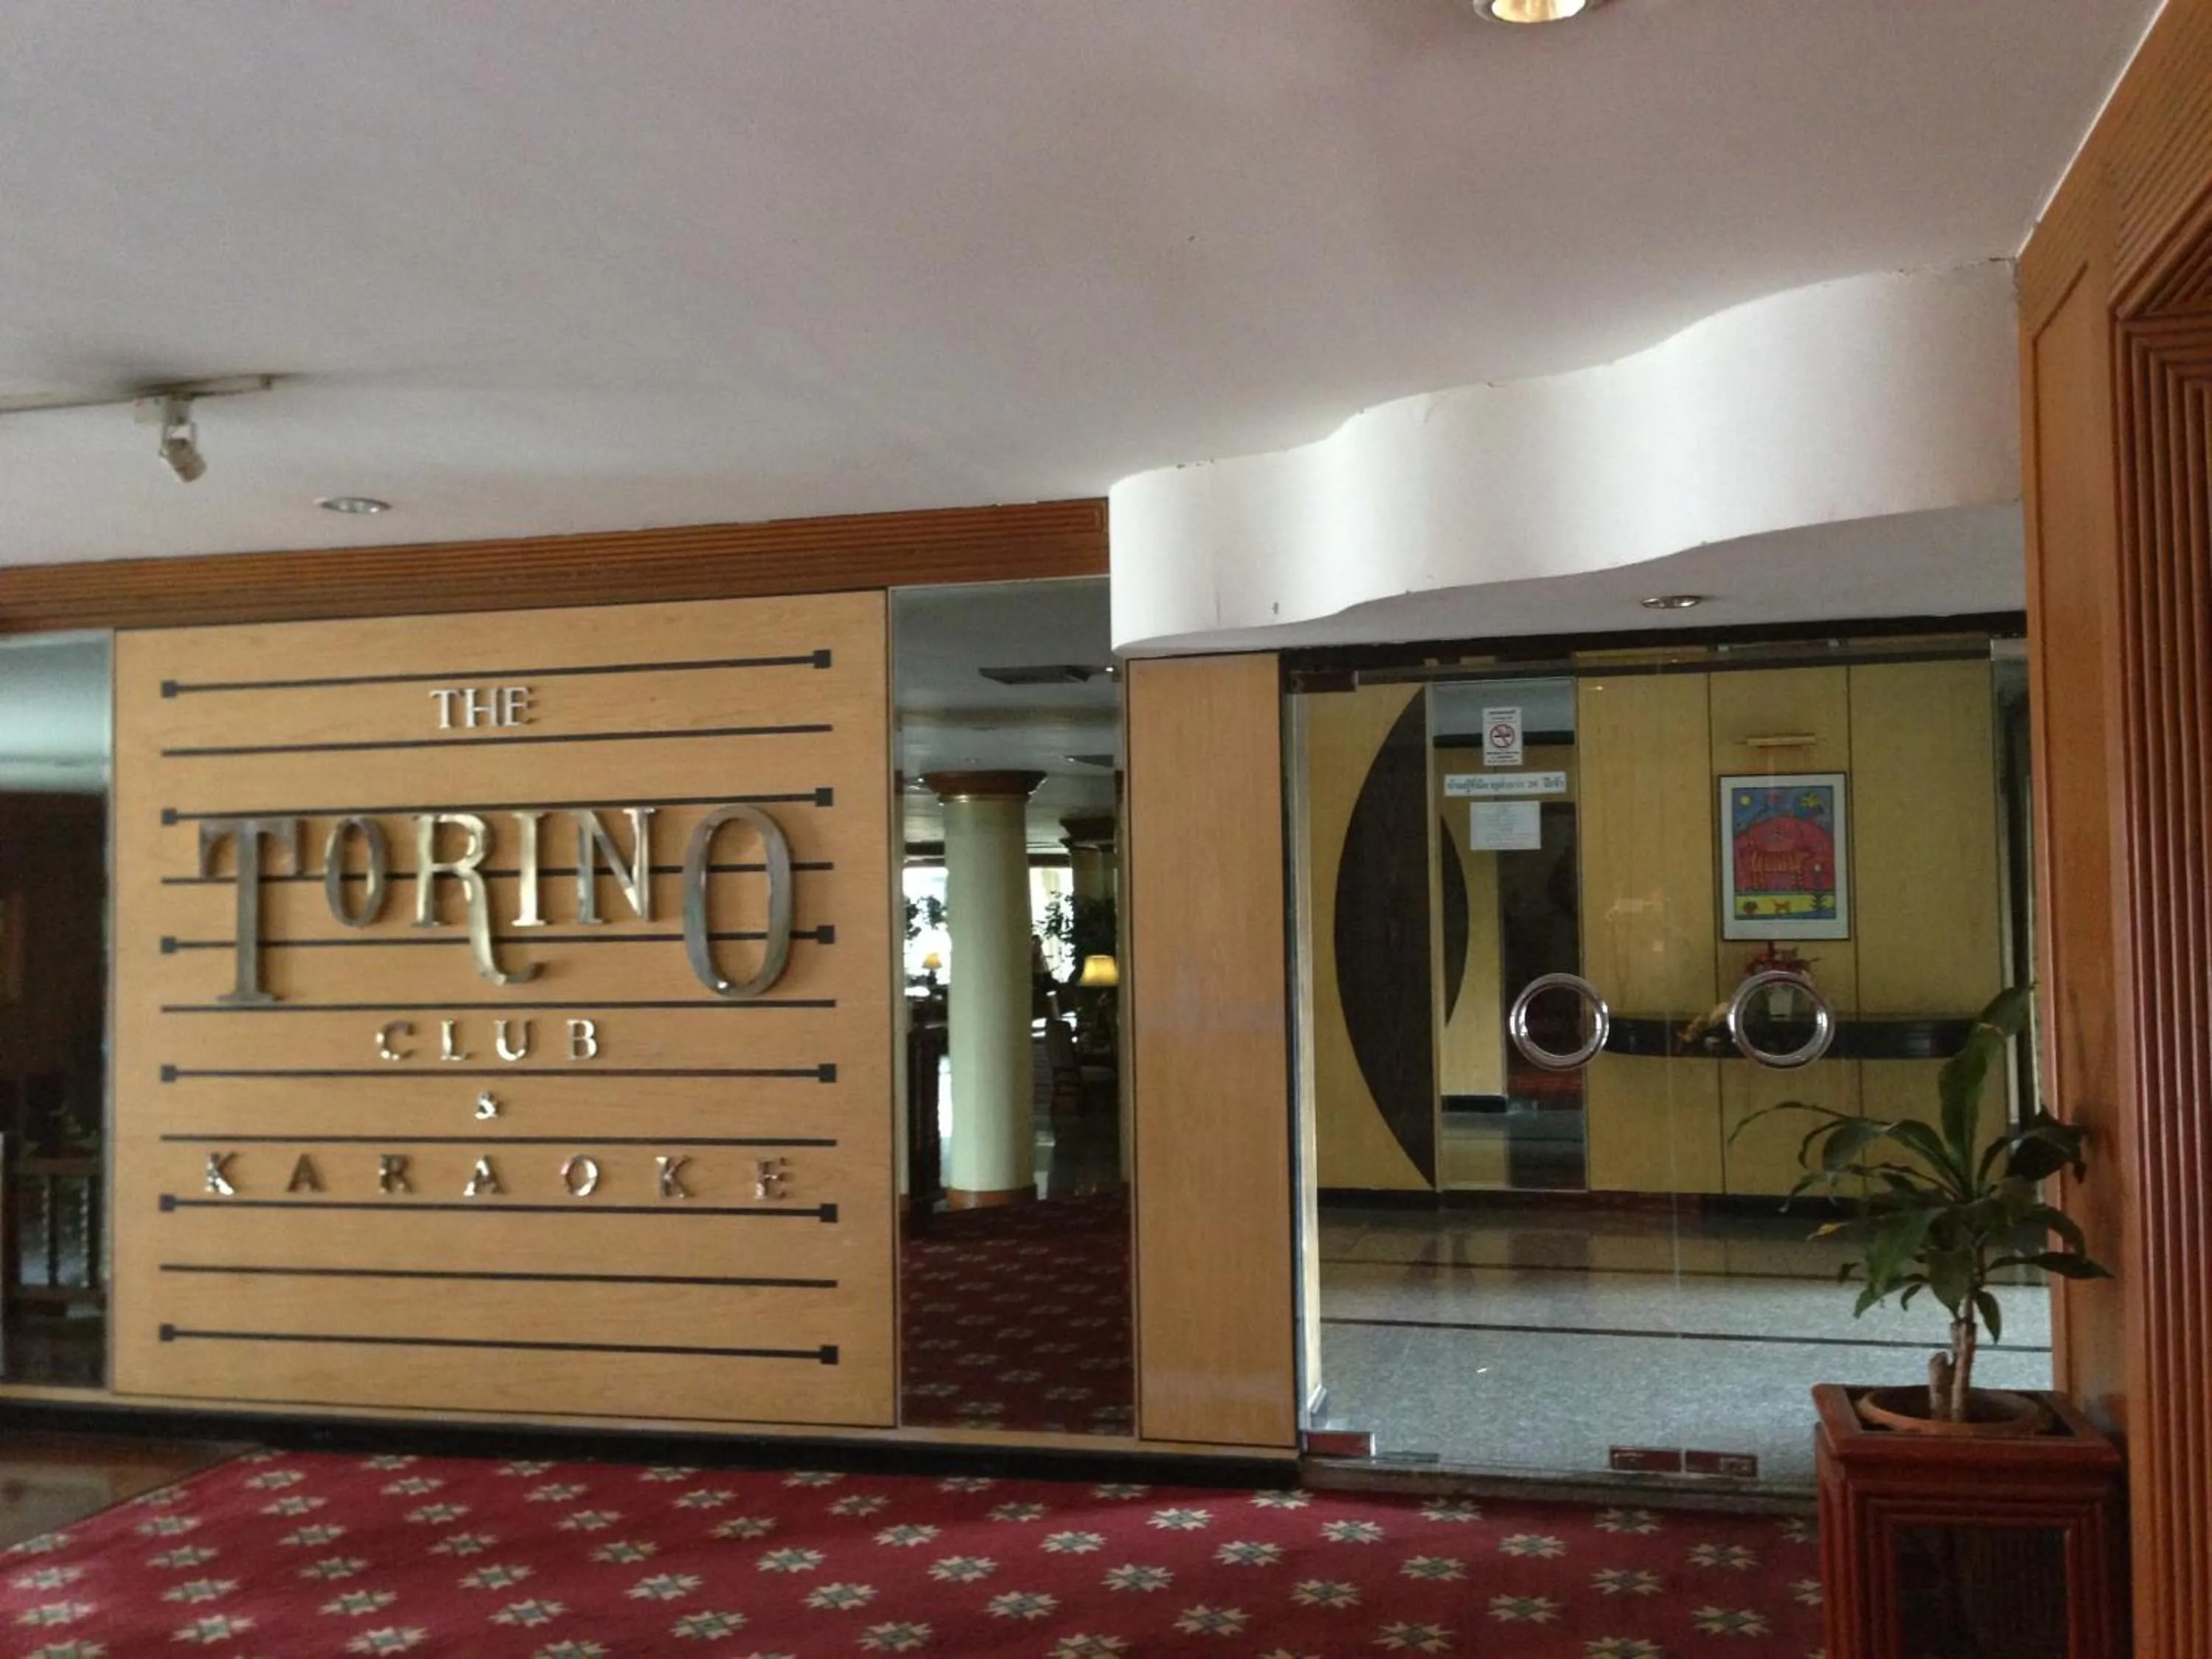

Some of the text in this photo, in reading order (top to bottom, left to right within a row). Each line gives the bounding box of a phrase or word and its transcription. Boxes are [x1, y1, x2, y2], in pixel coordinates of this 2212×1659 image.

[430, 686, 534, 728] THE
[198, 804, 792, 1006] TORINO
[376, 1019, 599, 1062] CLUB
[474, 1091, 499, 1120] &
[205, 1152, 792, 1200] KARAOKE
